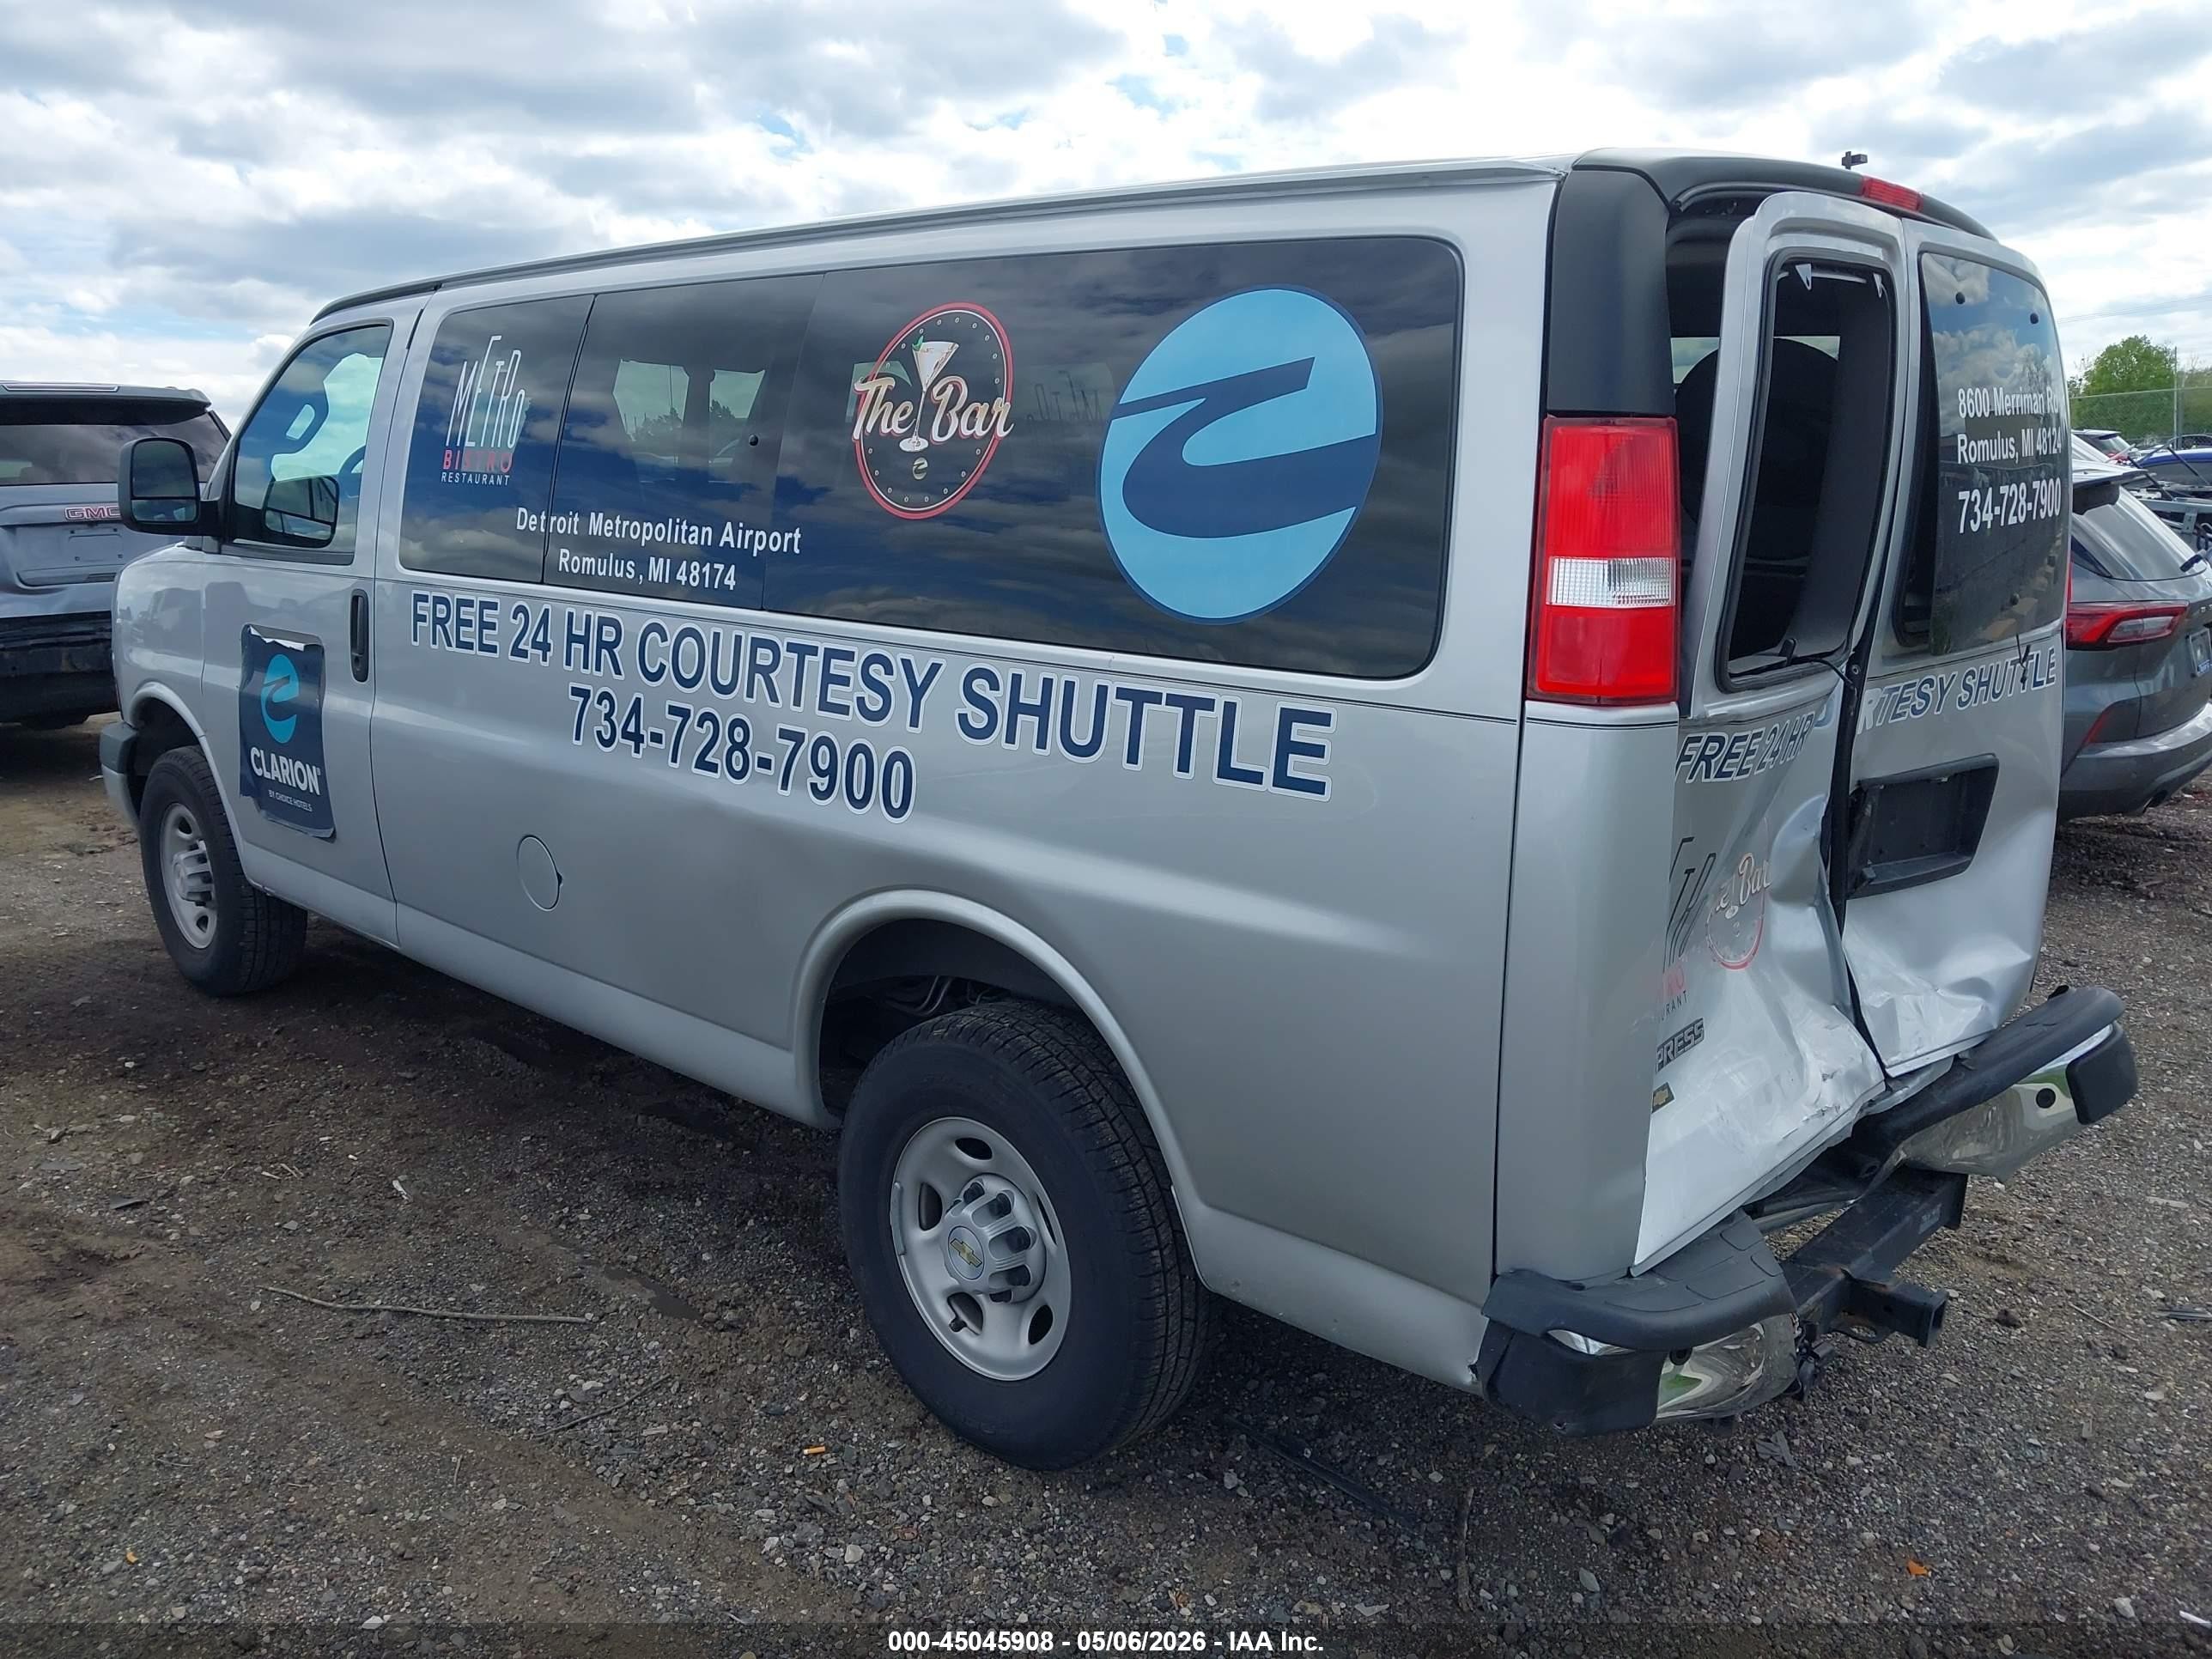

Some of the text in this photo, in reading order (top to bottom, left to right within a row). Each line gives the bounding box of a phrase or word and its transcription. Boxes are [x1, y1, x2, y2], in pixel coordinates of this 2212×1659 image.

[445, 335, 526, 448] METRO
[852, 375, 1015, 445] The Bar
[1958, 387, 1990, 418] 8600
[1993, 386, 2045, 416] Merriman
[442, 449, 514, 473] BISTRO
[1957, 426, 2062, 465] Romulus, MI 48124
[441, 471, 511, 486] RESTAURANT
[64, 507, 121, 521] GMC
[1958, 477, 2061, 533] 734-728-7900
[516, 507, 802, 557] Detroit Metropolitan Airport
[648, 556, 671, 583] MI
[676, 561, 736, 591] 48174
[410, 591, 1338, 802] FREE 24 HR COURTESY SHUTTLE
[1674, 727, 1766, 784] FREE
[1754, 718, 1790, 775] 24
[1856, 671, 1958, 735] RTESY
[1956, 646, 2057, 710] SHUTTLE
[568, 682, 917, 824] 734-728-7900
[1656, 1018, 1705, 1073] PRESS
